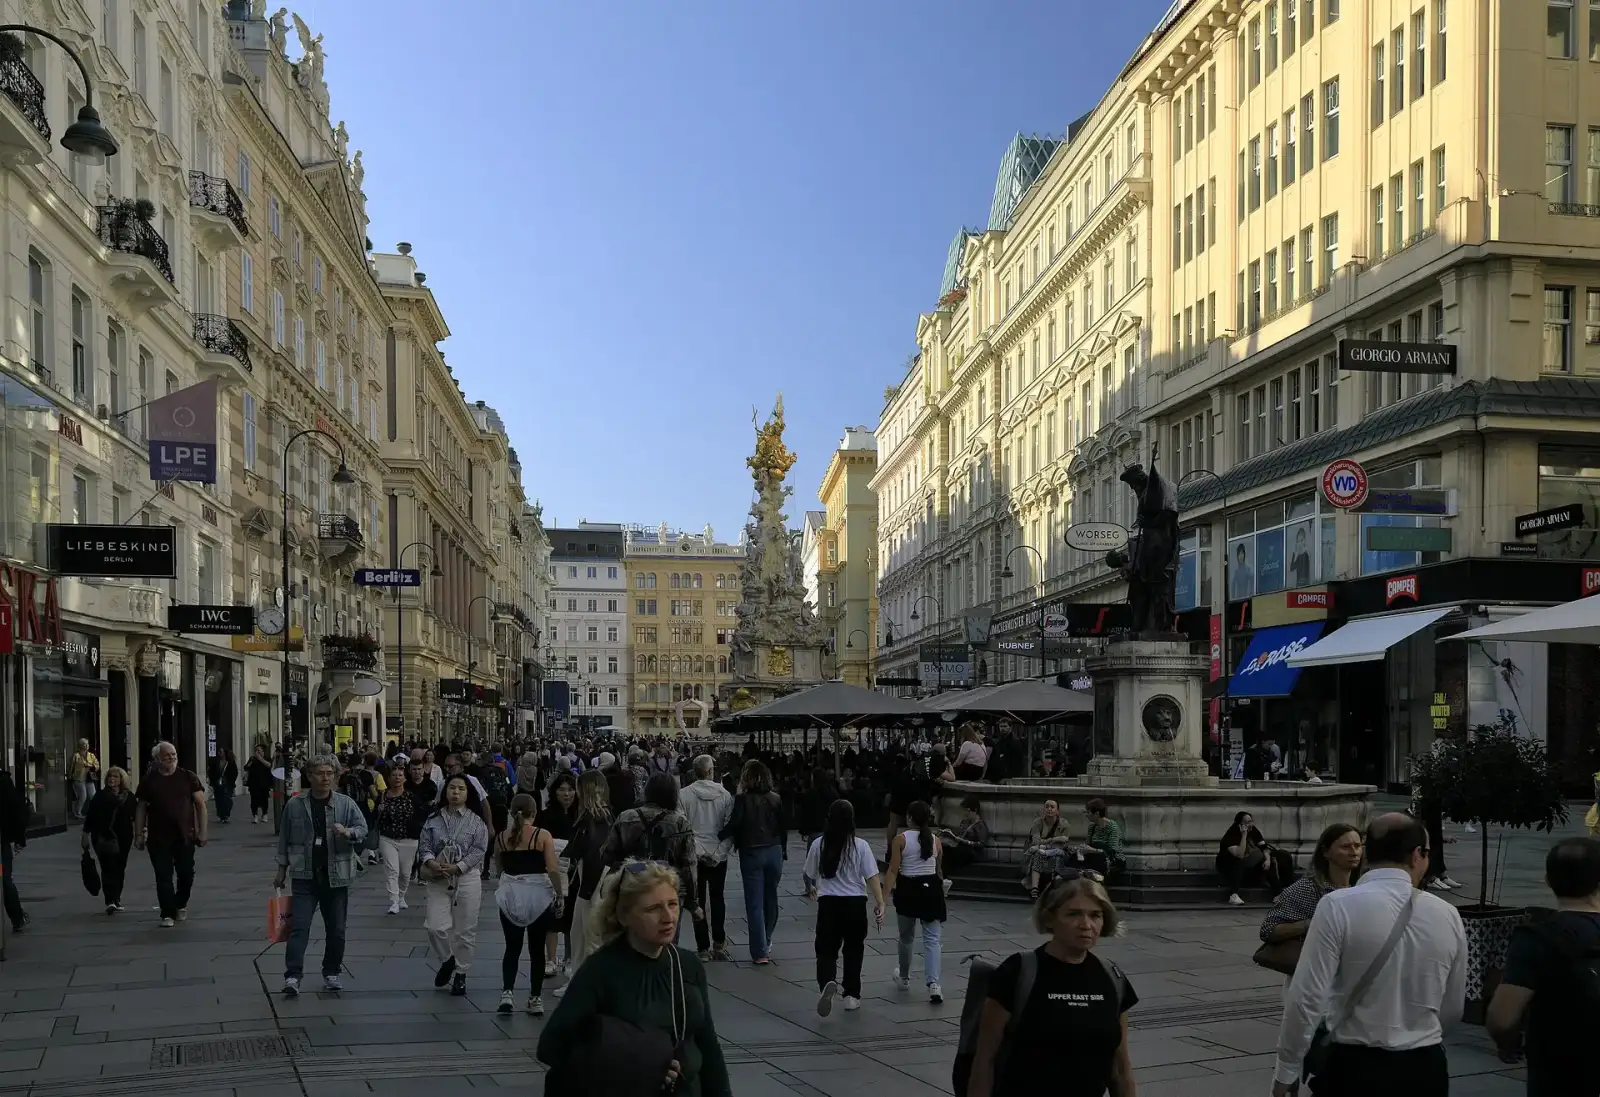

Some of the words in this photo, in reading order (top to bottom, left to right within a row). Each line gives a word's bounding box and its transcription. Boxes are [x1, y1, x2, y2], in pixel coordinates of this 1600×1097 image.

[1350, 347, 1401, 363] GIORGIO
[1404, 351, 1450, 366] ARMANI
[160, 445, 207, 466] LPE
[1334, 476, 1357, 491] VVD
[1519, 516, 1545, 531] GIORGIO
[1545, 509, 1570, 525] ARMANI
[1075, 530, 1120, 539] WORSEG
[66, 540, 170, 552] LIEBESKIND
[365, 571, 413, 583] Berlitz
[1387, 578, 1416, 598] CAMPER
[1297, 593, 1327, 605] CAMPER
[200, 609, 231, 622] IWC
[189, 623, 241, 631] SCHAFFHAUSEN
[1047, 992, 1071, 1000] UPPER
[1072, 993, 1089, 1001] EAST
